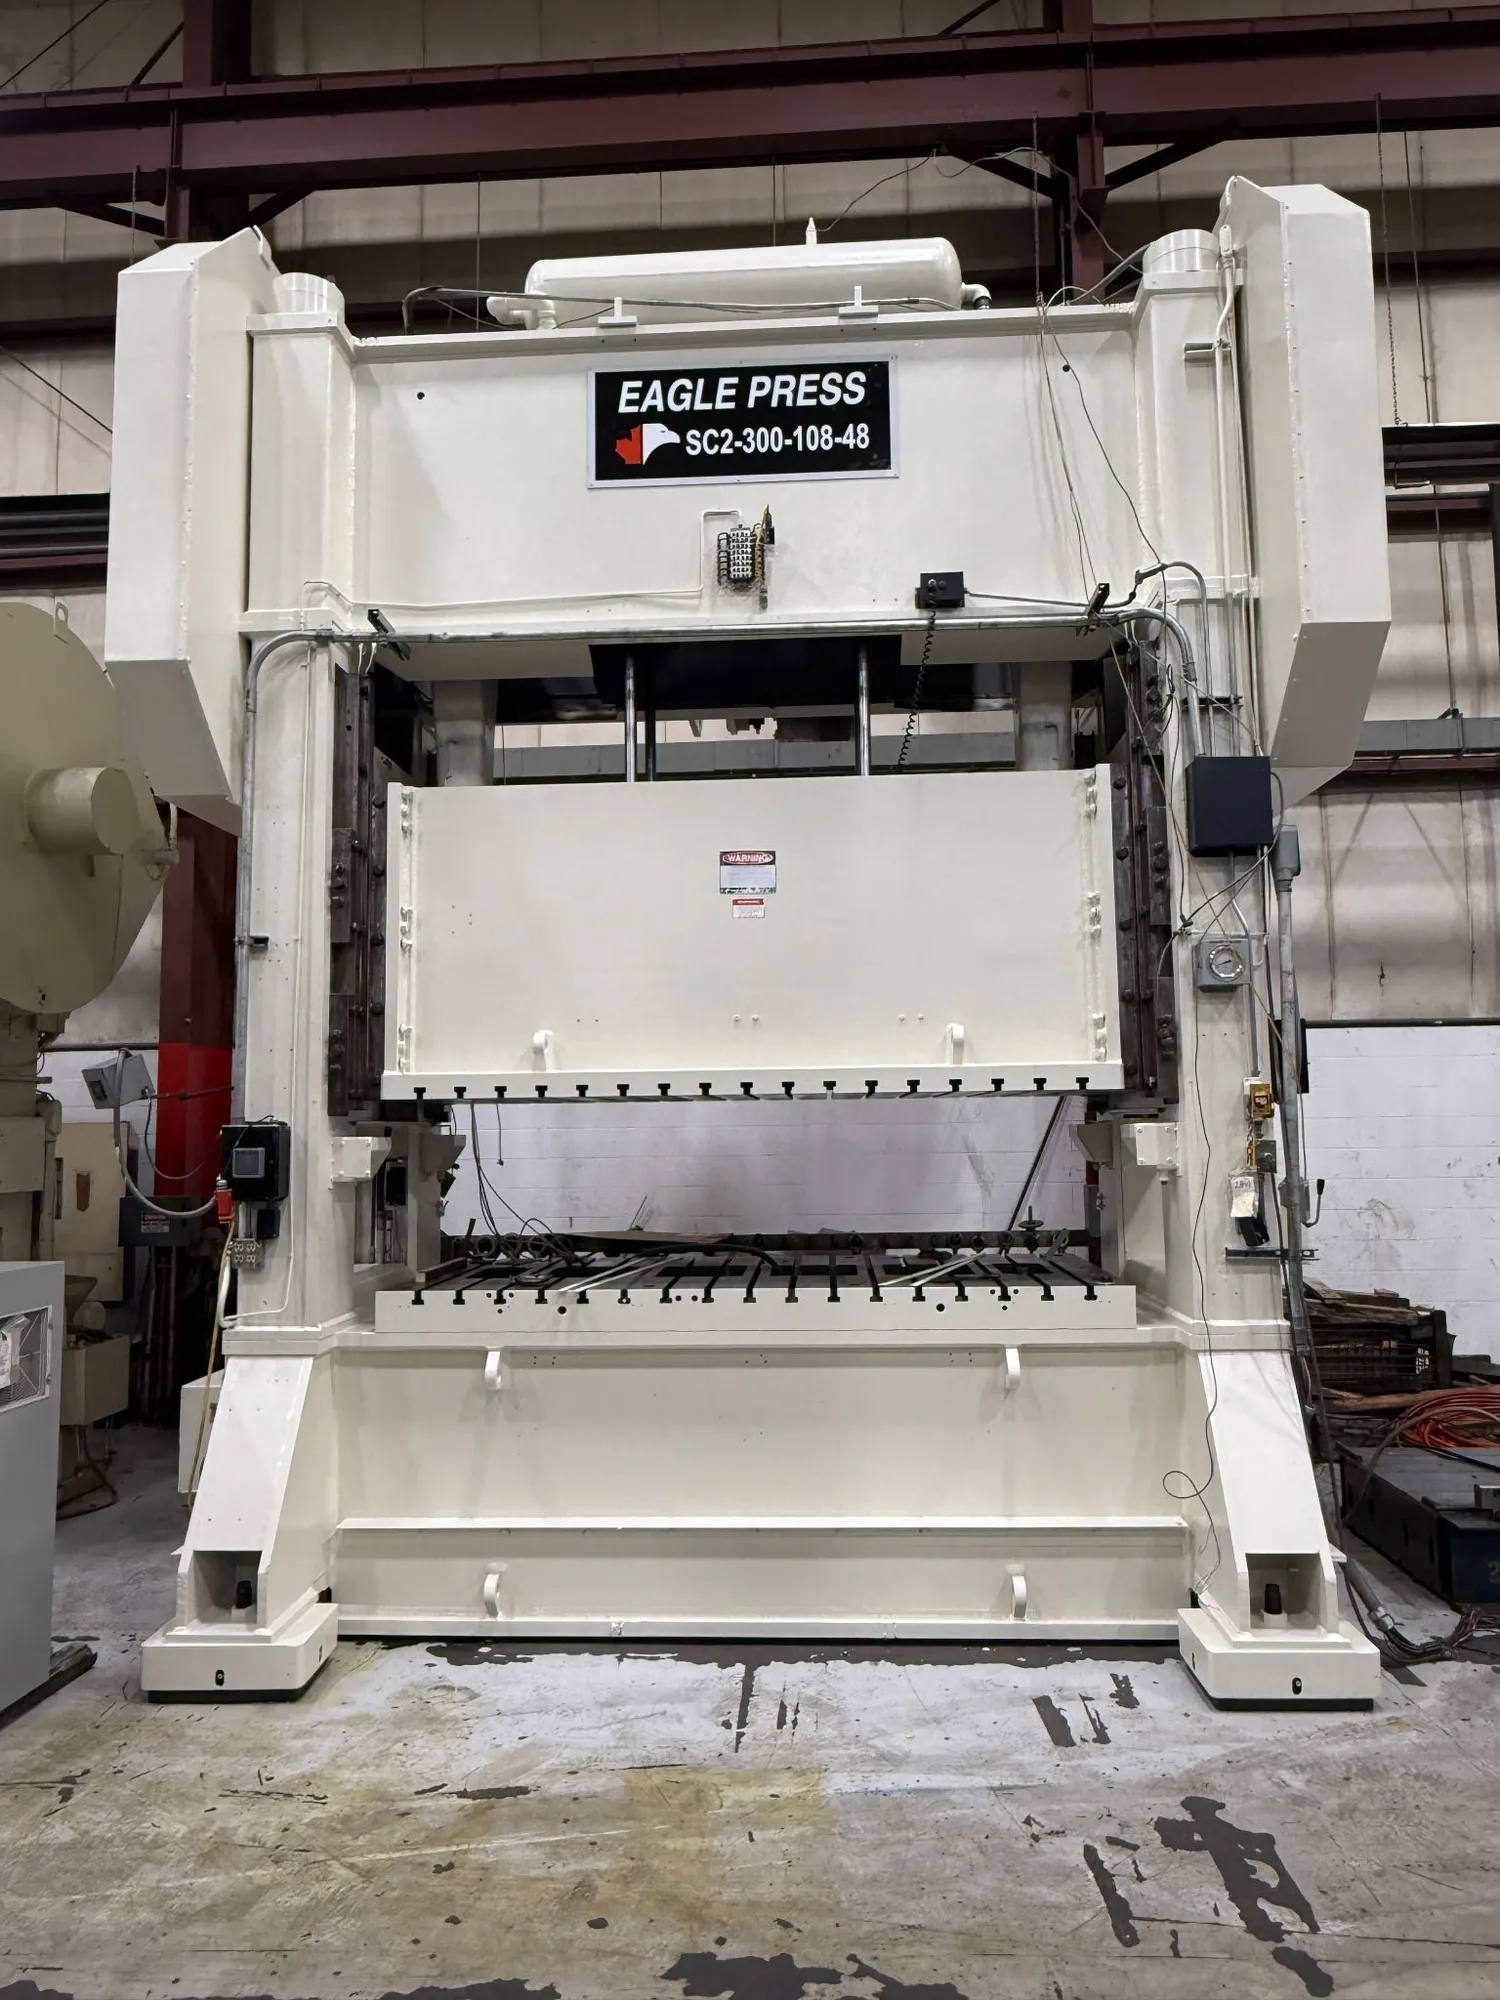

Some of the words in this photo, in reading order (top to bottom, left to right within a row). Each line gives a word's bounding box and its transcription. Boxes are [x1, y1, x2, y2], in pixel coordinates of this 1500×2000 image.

[618, 376, 739, 413] EAGLE
[747, 371, 867, 408] PRESS
[685, 423, 870, 456] SC2-300-108-48
[728, 854, 769, 862] WARNING
